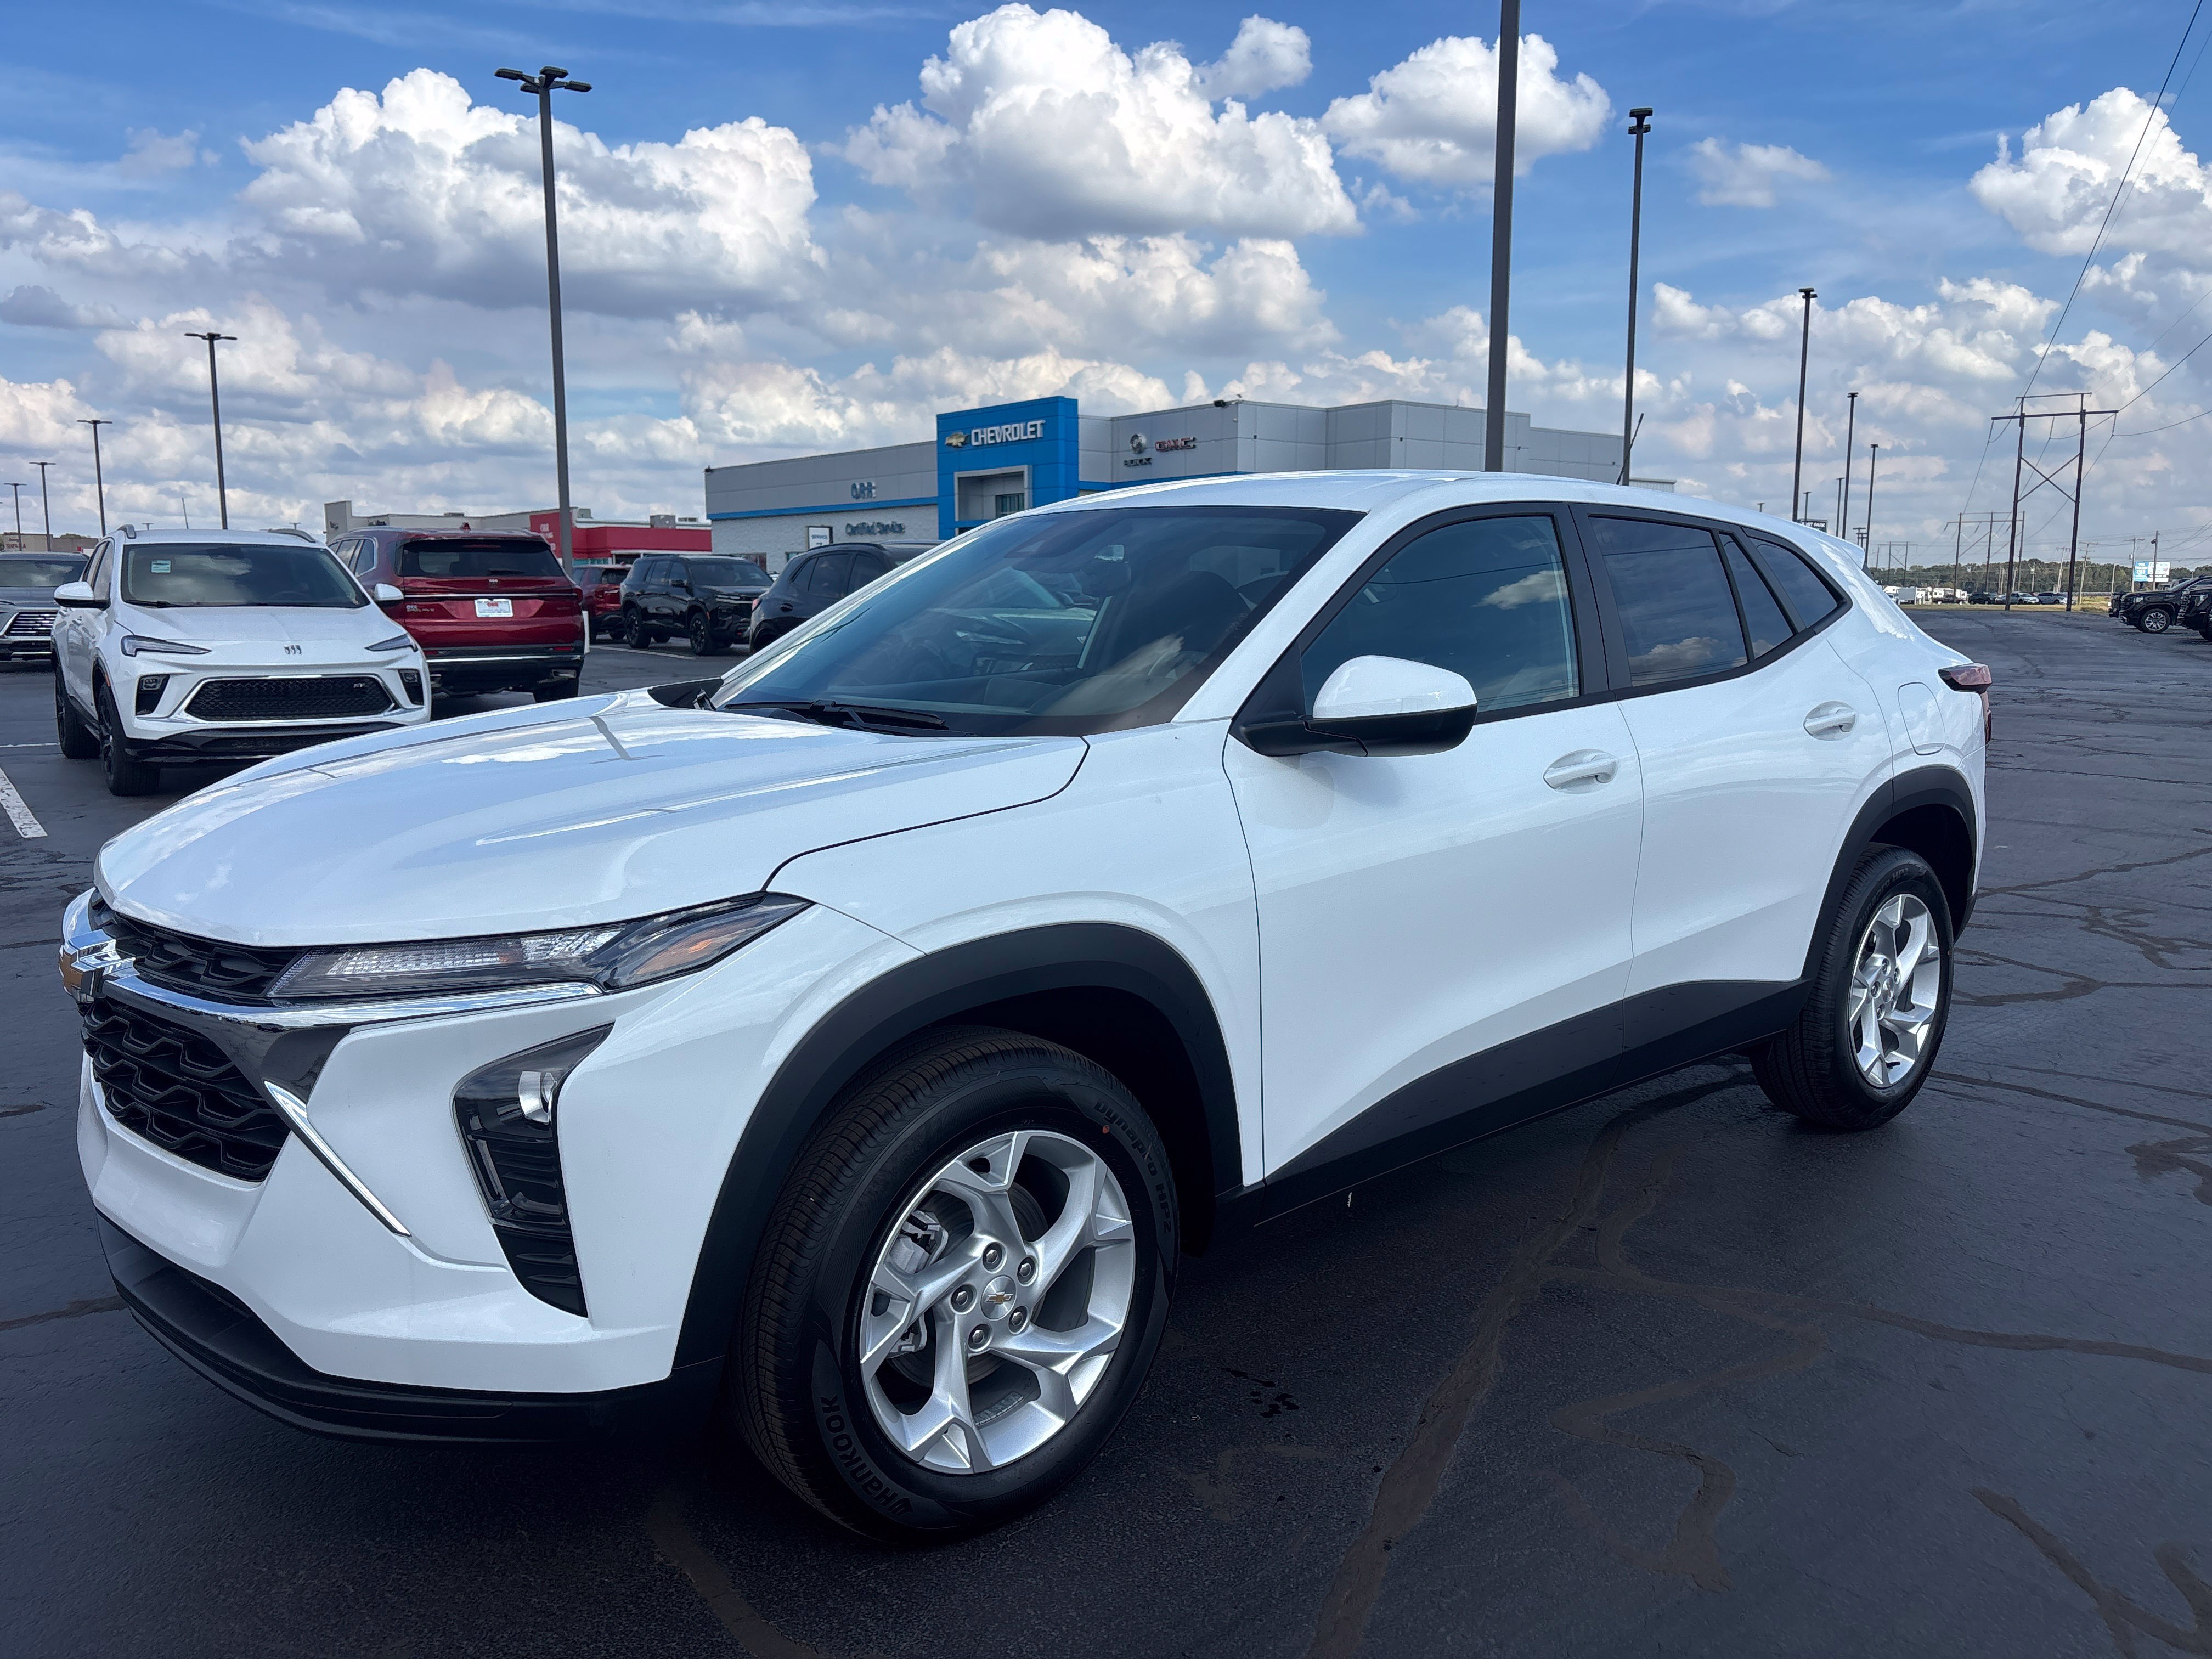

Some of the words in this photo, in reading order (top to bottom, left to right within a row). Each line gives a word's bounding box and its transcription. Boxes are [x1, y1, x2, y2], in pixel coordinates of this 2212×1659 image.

[971, 420, 1046, 445] CHEVROLET
[1155, 437, 1196, 452] GMC
[1124, 458, 1152, 466] BUICK
[1093, 1100, 1158, 1177] Dynapro
[1155, 1183, 1172, 1234] HP2
